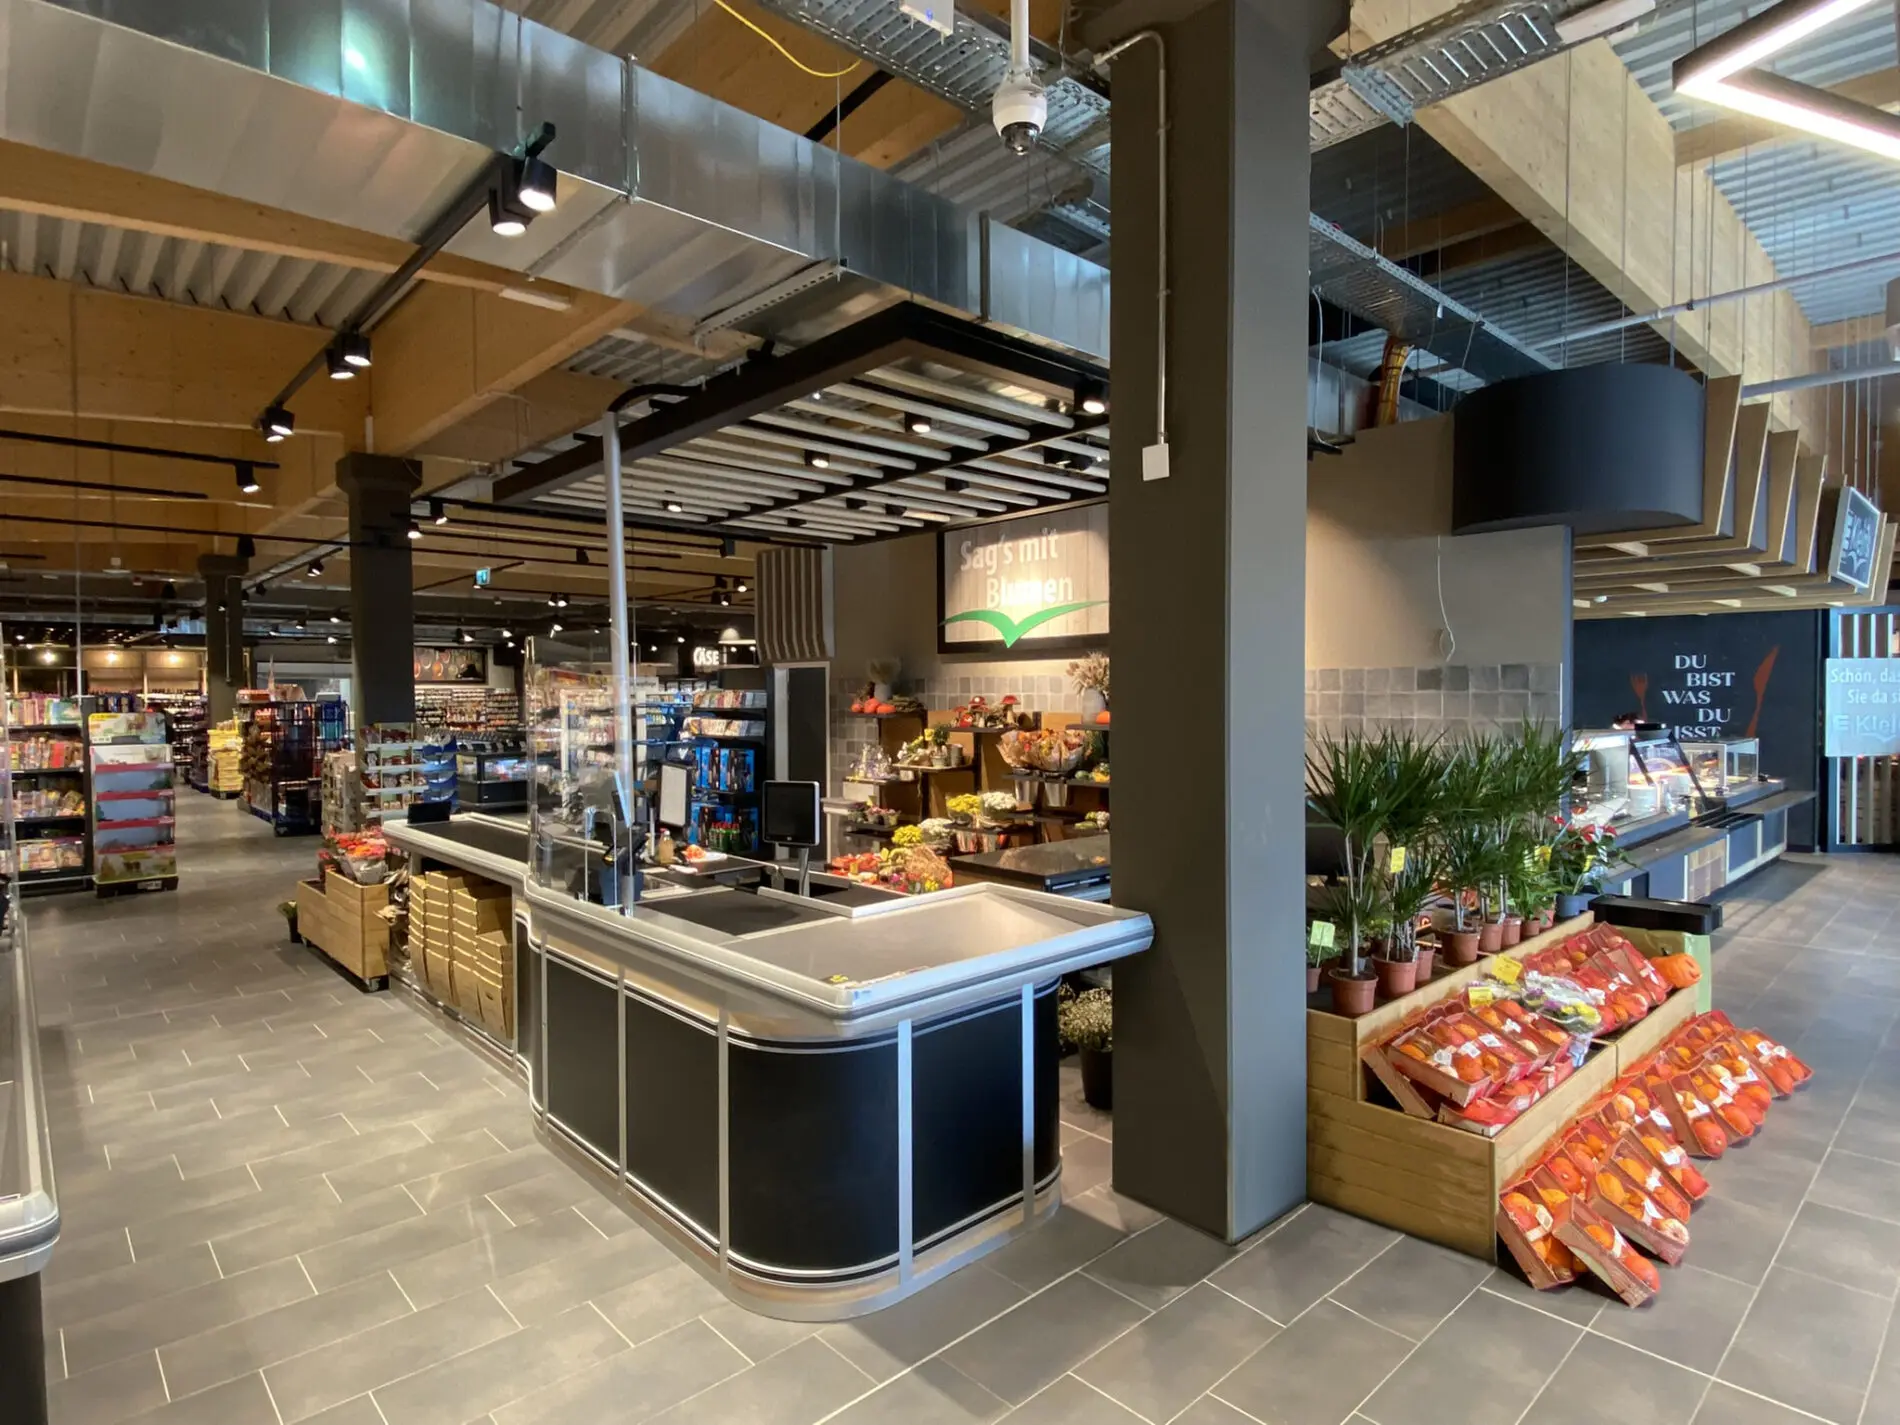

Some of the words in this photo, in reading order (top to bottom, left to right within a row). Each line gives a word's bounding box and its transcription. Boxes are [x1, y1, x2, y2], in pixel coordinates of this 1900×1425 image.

[961, 533, 1013, 576] Sag's
[1019, 527, 1059, 563] mit
[986, 575, 1074, 609] Blen
[1675, 654, 1707, 669] DU
[1686, 672, 1736, 687] BIST
[1831, 667, 1877, 684] Schön,
[1662, 690, 1711, 705] WAS
[1847, 688, 1868, 704] Sie
[1871, 688, 1888, 704] da
[1698, 708, 1732, 723] DU
[1674, 725, 1722, 739] ISST
